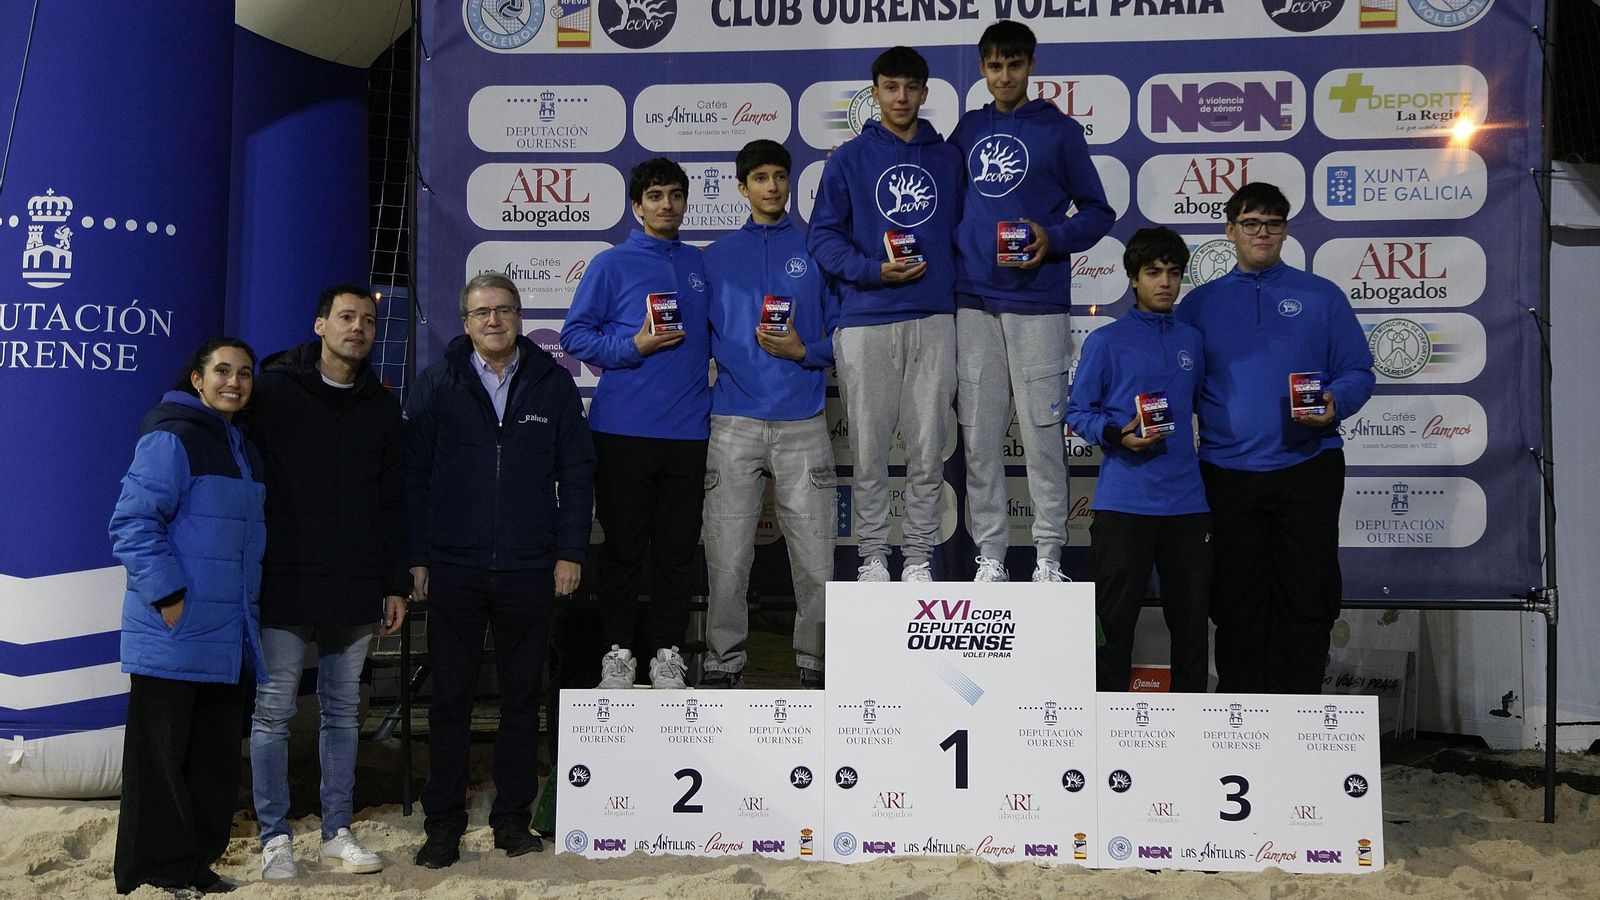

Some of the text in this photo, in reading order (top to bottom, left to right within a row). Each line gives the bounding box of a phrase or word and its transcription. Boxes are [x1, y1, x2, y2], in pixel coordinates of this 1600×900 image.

[711, 0, 802, 28] CLUB
[812, 0, 979, 25] OURENSE
[993, 0, 1098, 19] VOLEI
[1291, 2, 1332, 14] COVP
[1416, 0, 1485, 26] VOLEIBOL
[626, 18, 664, 32] COVP
[476, 24, 537, 48] VOLEIBOL
[696, 100, 728, 109] Cafés
[1033, 80, 1094, 117] RL
[1206, 96, 1244, 105] violencia
[1367, 92, 1473, 110] DEPORTE
[1151, 81, 1293, 133] NON
[1200, 104, 1243, 114] de xénero
[645, 113, 664, 124] LAS
[664, 105, 718, 128] ANTILLAS
[732, 102, 778, 126] Campos
[1396, 109, 1460, 122] La Regi
[505, 124, 589, 137] DEPUTACIÓN
[516, 138, 577, 149] OURENSE
[985, 172, 1014, 183] COVP
[1364, 168, 1430, 183] XUNTA
[502, 168, 590, 204] ARL
[1363, 185, 1473, 201] DE GALICIA
[688, 202, 752, 213] PUTACIÓN
[900, 200, 929, 213] COVP
[501, 205, 590, 227] abogados
[682, 215, 741, 226] OURENSE
[530, 258, 561, 266] Cafés
[1352, 242, 1447, 280] ARL
[1350, 282, 1447, 305] abogados
[0, 299, 174, 338] UTACIÓN
[0, 341, 139, 372] RENSE
[1383, 366, 1415, 376] OURENSE
[1382, 412, 1416, 422] Cafés
[1350, 417, 1405, 440] ANTILLAS
[1422, 415, 1472, 440] Campos
[1355, 517, 1445, 531] DEPUTACIÓN
[1367, 532, 1433, 544] OURENSE
[914, 600, 1012, 620] XVI COPA
[907, 620, 1015, 634] DEPUTACIÓN
[907, 635, 1015, 650] OURENSE
[573, 724, 633, 733] DEPUTACIÓN
[660, 724, 723, 734] DEPUTACIÓN
[750, 725, 811, 735] DEPUTACIÓN
[839, 726, 901, 735] DEPUTACIÓN
[1019, 728, 1083, 737] DEPUTACIÓN
[1111, 729, 1175, 738] DEPUTACIÓN
[1203, 730, 1270, 740] DEPUTACIÓN
[580, 735, 625, 743] OURENSE
[757, 736, 803, 744] OURENSE
[1028, 739, 1074, 747] OURENSE
[1298, 732, 1365, 741] DEPUTACIÓN
[1119, 740, 1167, 748] OURENSE
[1212, 741, 1261, 749] OURENSE
[1307, 743, 1356, 751] OURENSE
[939, 730, 968, 789] 1
[673, 769, 703, 813] 2
[1220, 775, 1251, 821] 3
[604, 795, 636, 810] ARL
[738, 796, 770, 811] ARL
[873, 791, 914, 810] ARL
[1000, 793, 1041, 812] ARL
[1148, 802, 1180, 817] ARL
[1290, 805, 1324, 820] ARL
[593, 838, 626, 851] NON
[634, 839, 650, 850] LAS
[650, 832, 696, 854] ANTILLAS
[704, 831, 744, 854] Campos
[752, 840, 785, 853] NON
[863, 841, 896, 854] NON
[904, 843, 919, 853] LAS
[976, 835, 1017, 857] Campos
[1024, 843, 1058, 857] NON
[1138, 845, 1172, 859] NON
[1180, 848, 1197, 859] LAS
[1198, 841, 1246, 863] ANTILLAS
[1255, 840, 1297, 863] Campos
[1306, 849, 1341, 864] NON
